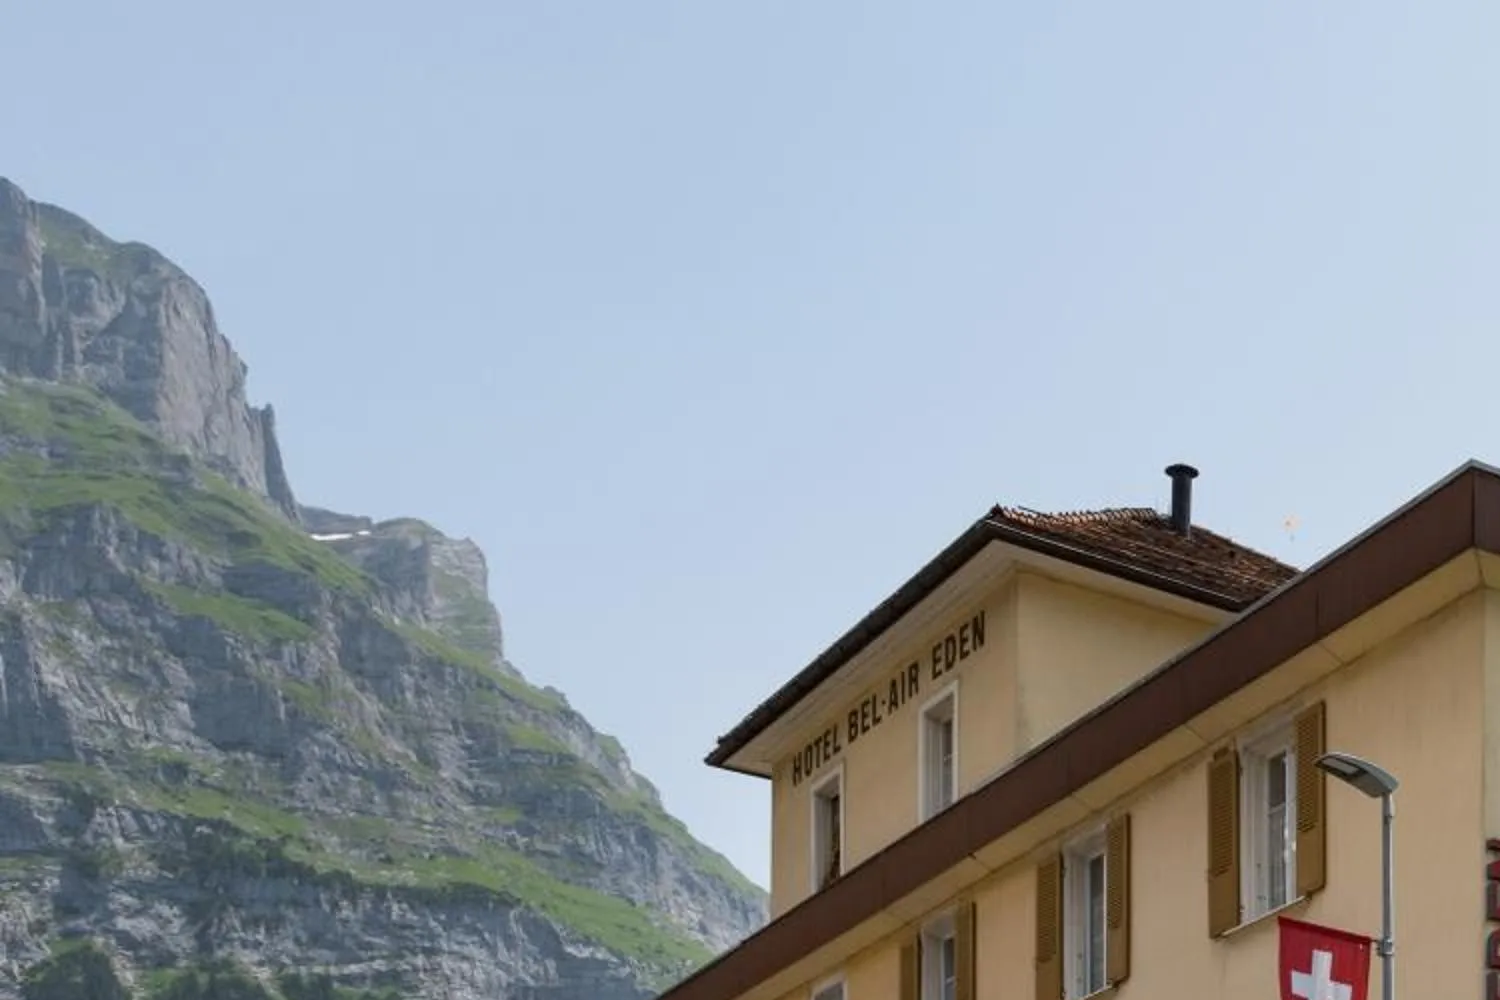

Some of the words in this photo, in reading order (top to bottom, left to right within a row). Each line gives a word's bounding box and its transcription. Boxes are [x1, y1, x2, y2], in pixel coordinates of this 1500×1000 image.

[792, 723, 842, 787] HOTEL
[847, 660, 920, 744] BEL-AIR
[931, 609, 986, 680] EDEN
